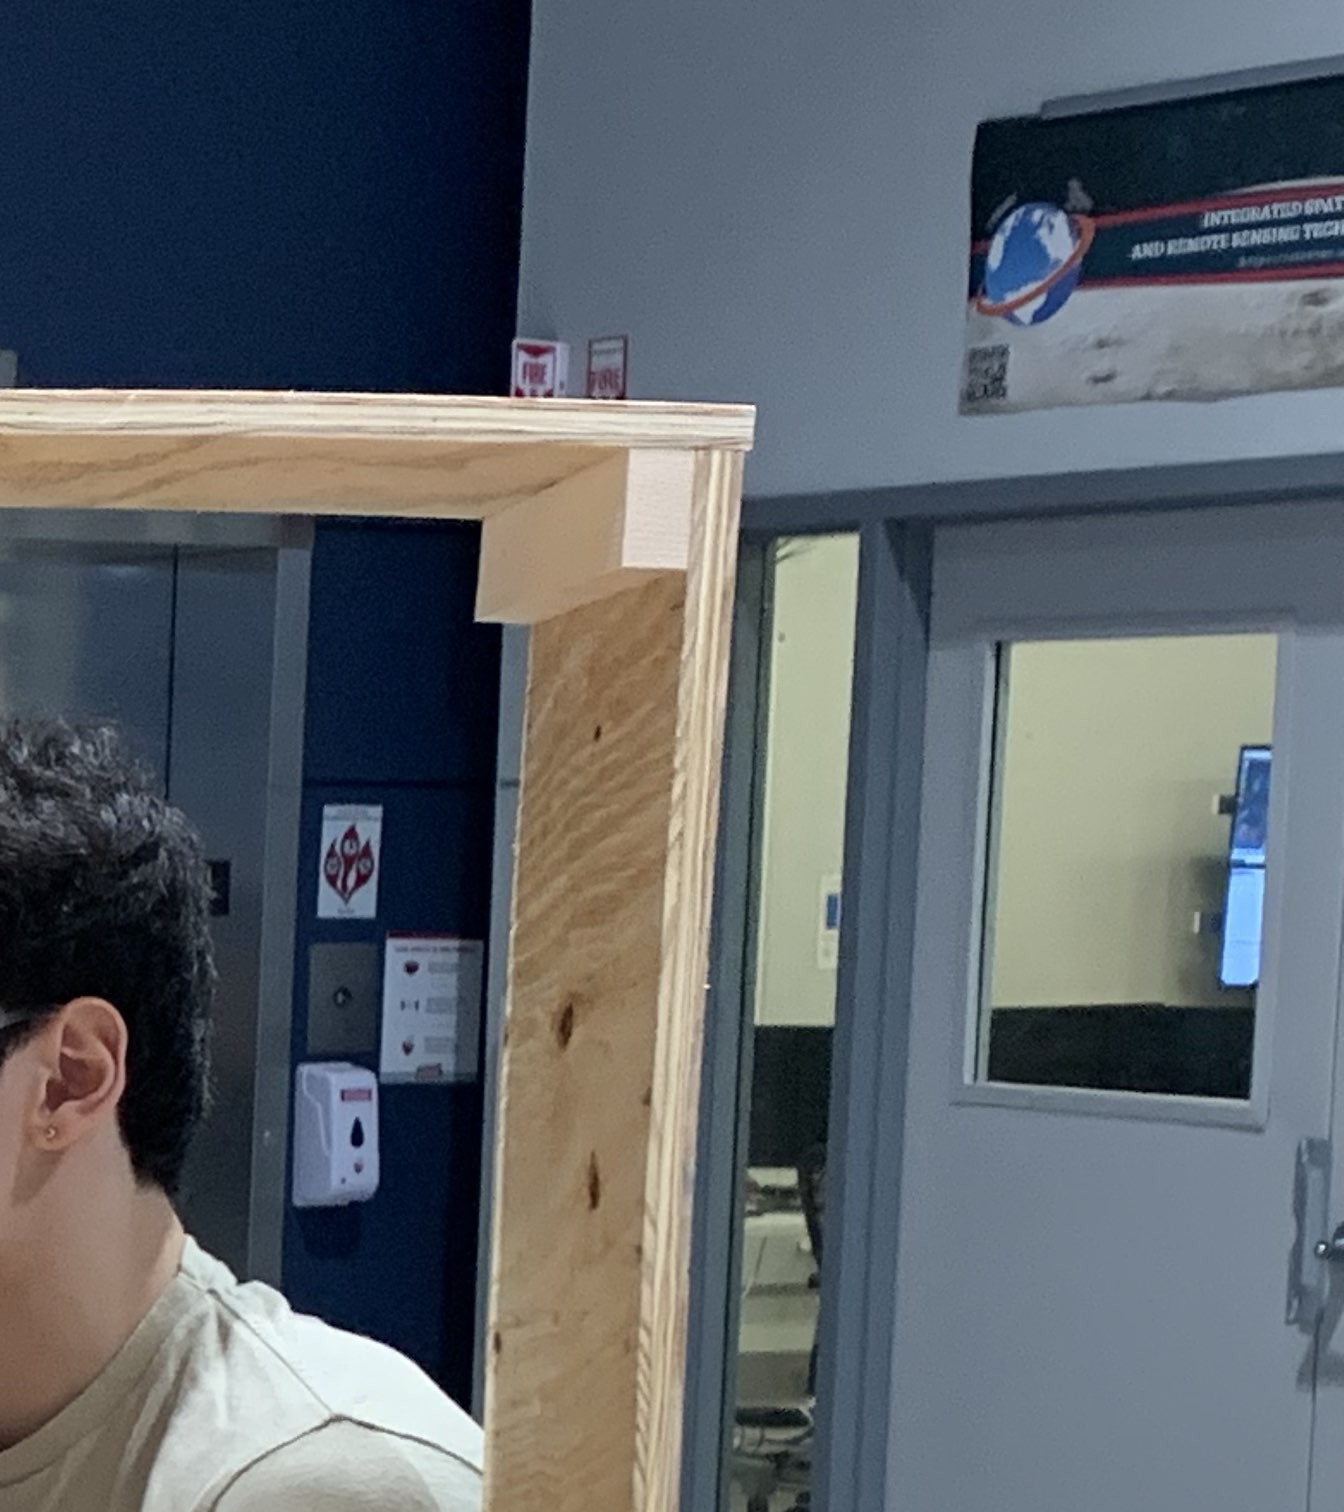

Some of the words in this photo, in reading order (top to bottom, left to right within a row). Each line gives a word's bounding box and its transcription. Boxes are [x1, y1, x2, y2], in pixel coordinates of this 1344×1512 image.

[1203, 201, 1303, 228] INTEGRATED
[1131, 242, 1165, 260] AND
[1166, 232, 1231, 256] REMOTE
[1232, 224, 1301, 248] SENSING
[523, 362, 547, 385] FIRE
